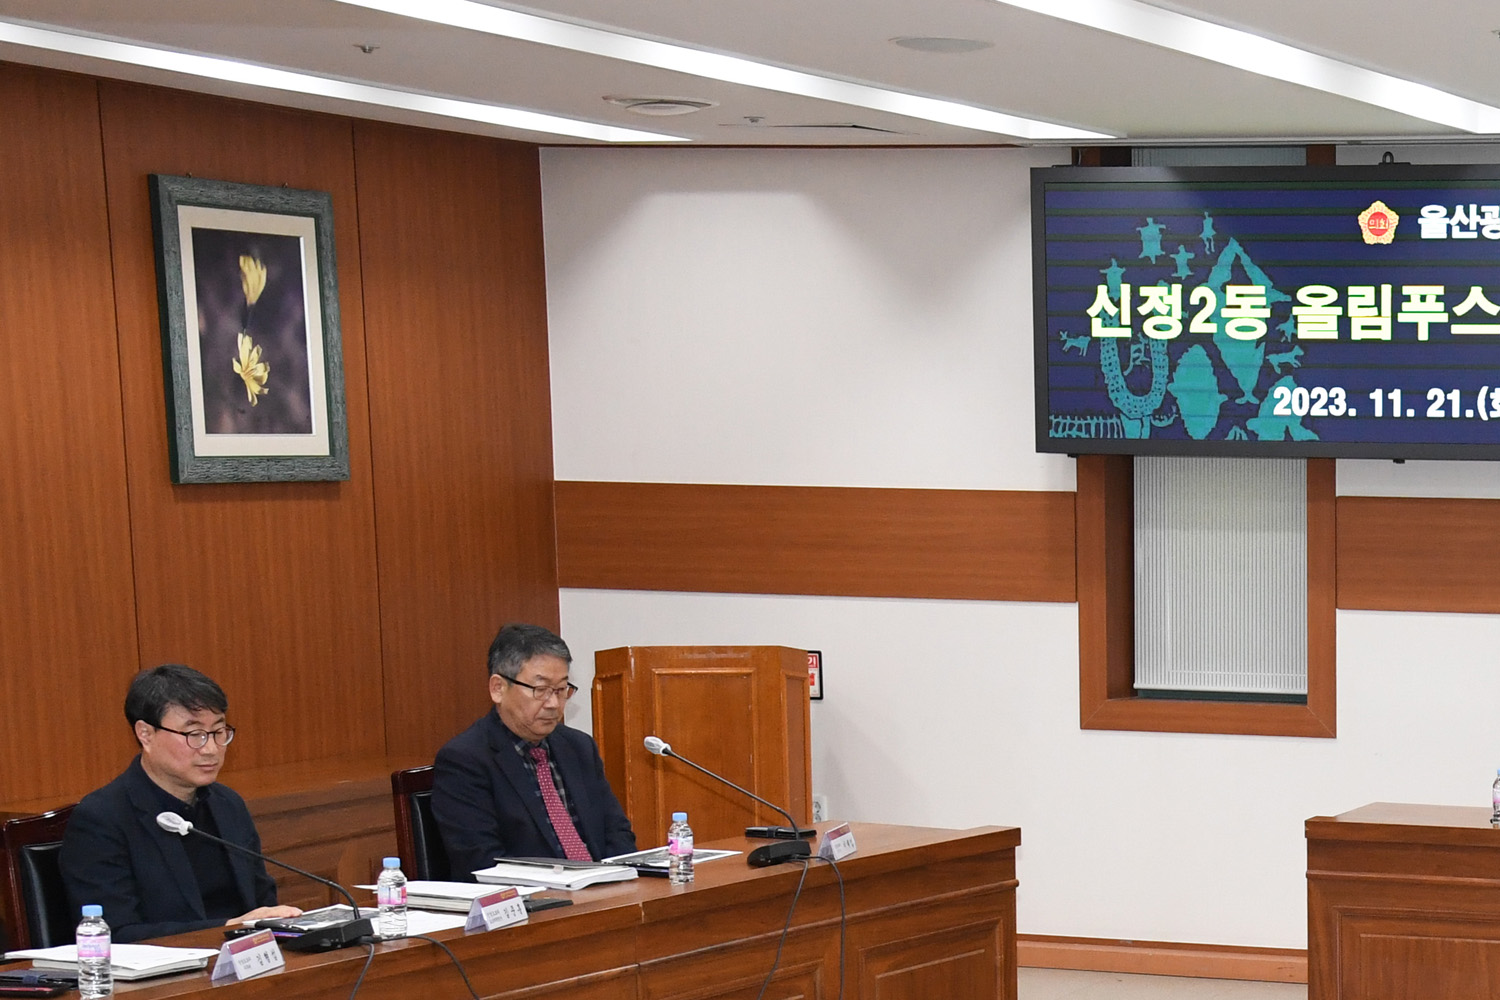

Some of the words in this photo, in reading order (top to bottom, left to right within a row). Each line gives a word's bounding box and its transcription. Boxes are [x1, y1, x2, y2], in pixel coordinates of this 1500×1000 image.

[1086, 283, 1271, 341] 신정2동
[1273, 386, 1357, 417] 2023.
[1369, 388, 1415, 418] 11.
